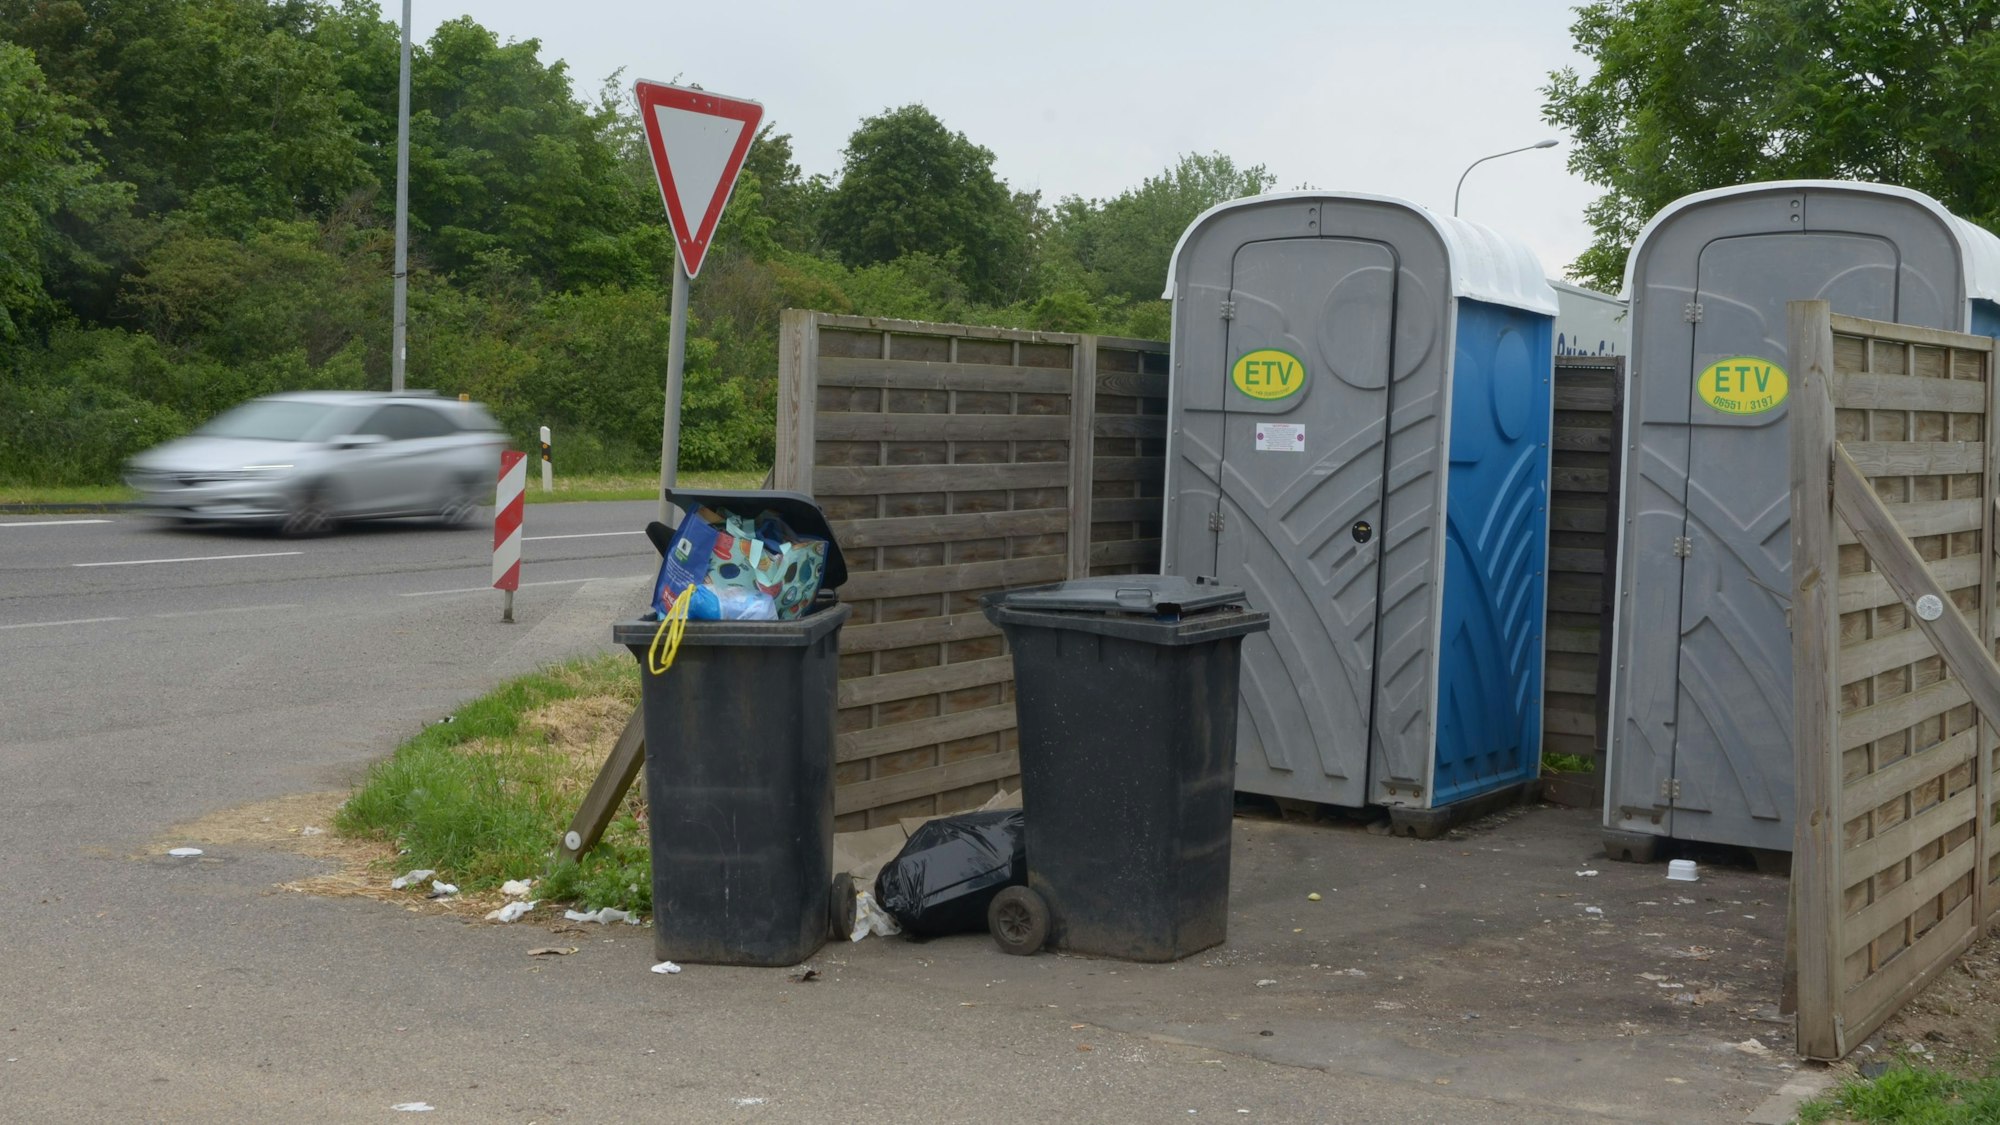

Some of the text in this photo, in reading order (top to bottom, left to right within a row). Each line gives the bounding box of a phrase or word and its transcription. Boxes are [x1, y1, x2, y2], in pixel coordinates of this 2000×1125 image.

[1245, 361, 1294, 385] ETV
[1715, 366, 1771, 392] ETV
[1713, 395, 1741, 410] 06551
[1750, 395, 1774, 410] 3197
